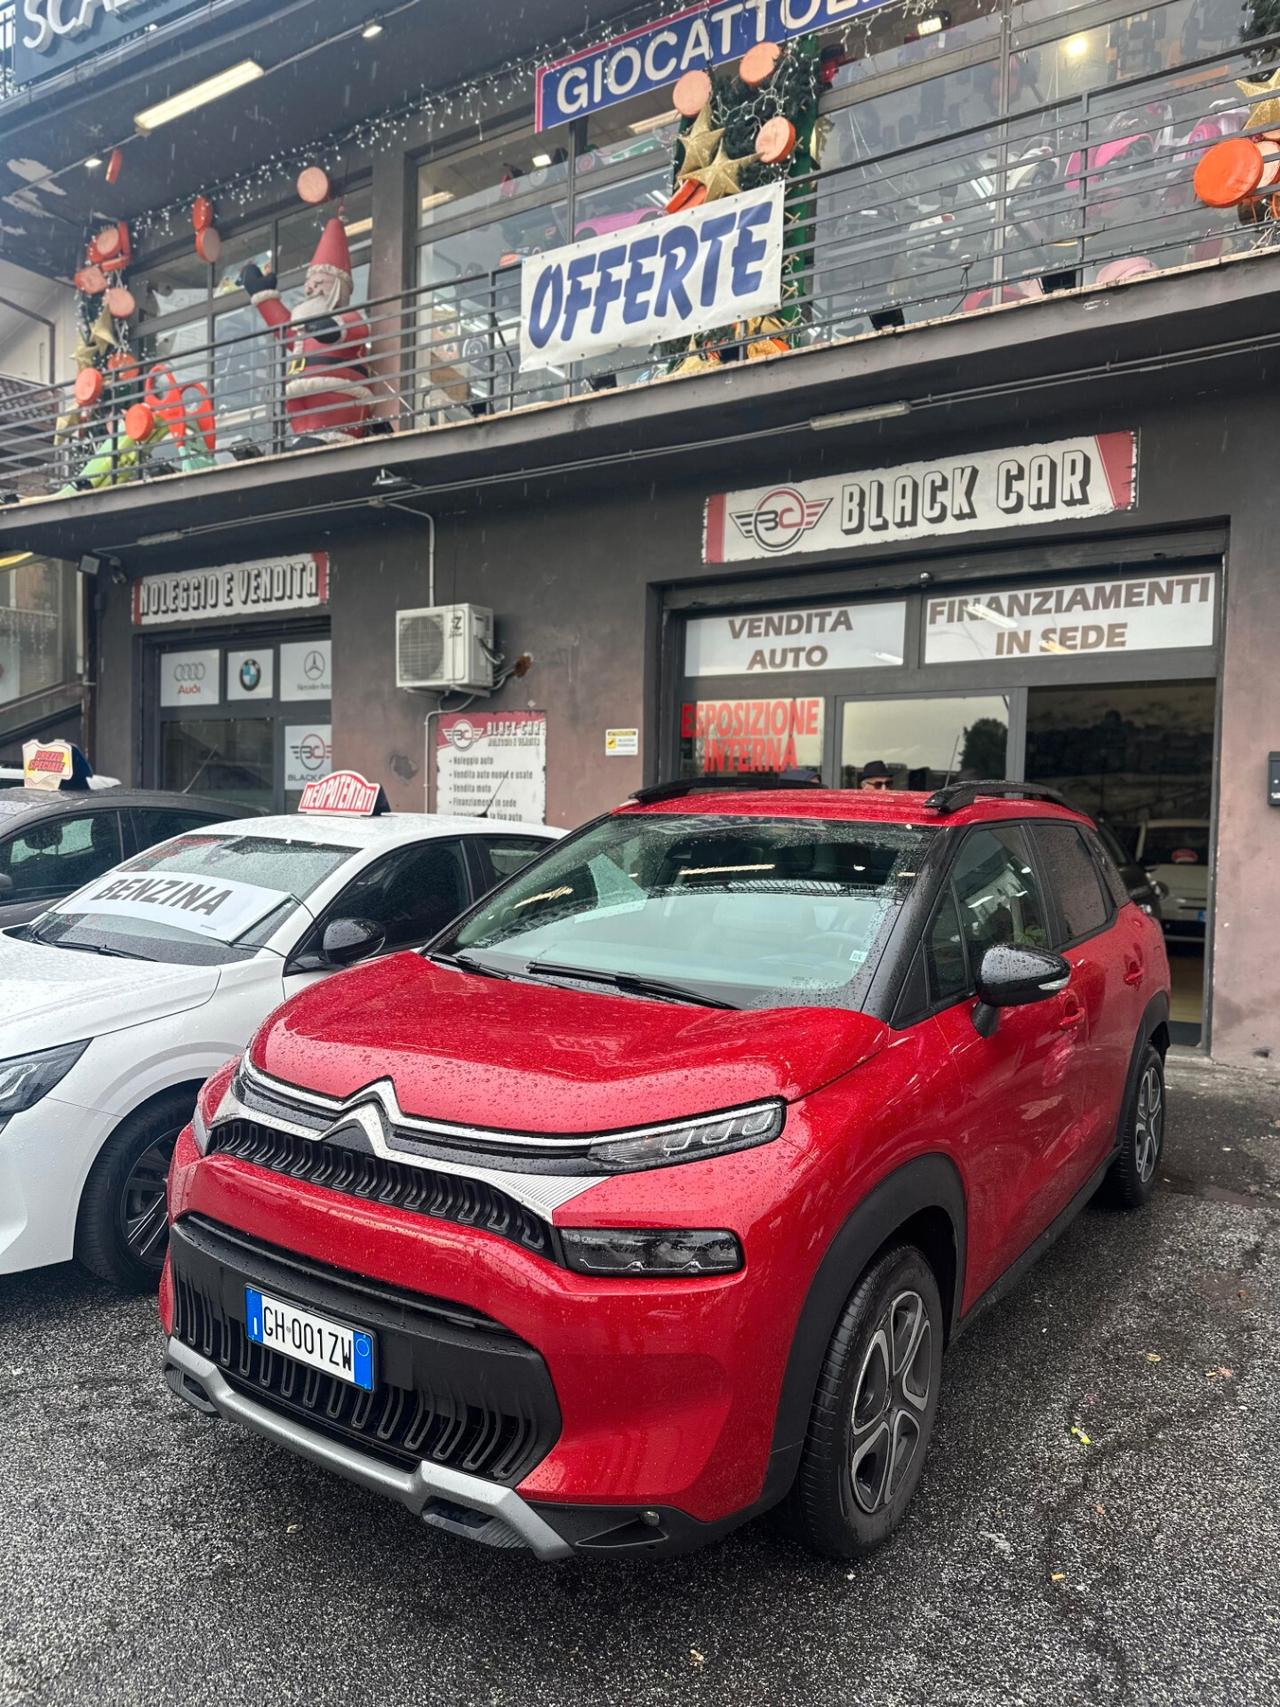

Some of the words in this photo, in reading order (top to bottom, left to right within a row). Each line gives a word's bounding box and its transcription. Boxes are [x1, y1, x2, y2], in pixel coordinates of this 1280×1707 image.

[529, 201, 773, 349] OFFERTE
[841, 465, 979, 535] BLACK
[996, 450, 1091, 514] CAR
[140, 575, 219, 616] NOLEGGIO
[224, 572, 234, 607] E
[239, 561, 320, 605] VENDITA
[929, 577, 1211, 625] FINANZIAMENTI
[728, 610, 854, 640] VENDITA
[995, 630, 1031, 656] IN
[1039, 622, 1128, 652] SEDE
[746, 645, 828, 671] AUTO
[177, 685, 202, 695] Audi
[681, 699, 820, 738] ESPOSIZIONE
[703, 737, 799, 773] INTERNA
[301, 775, 375, 810] NEOPATENTATI
[90, 878, 234, 917] BENZINA
